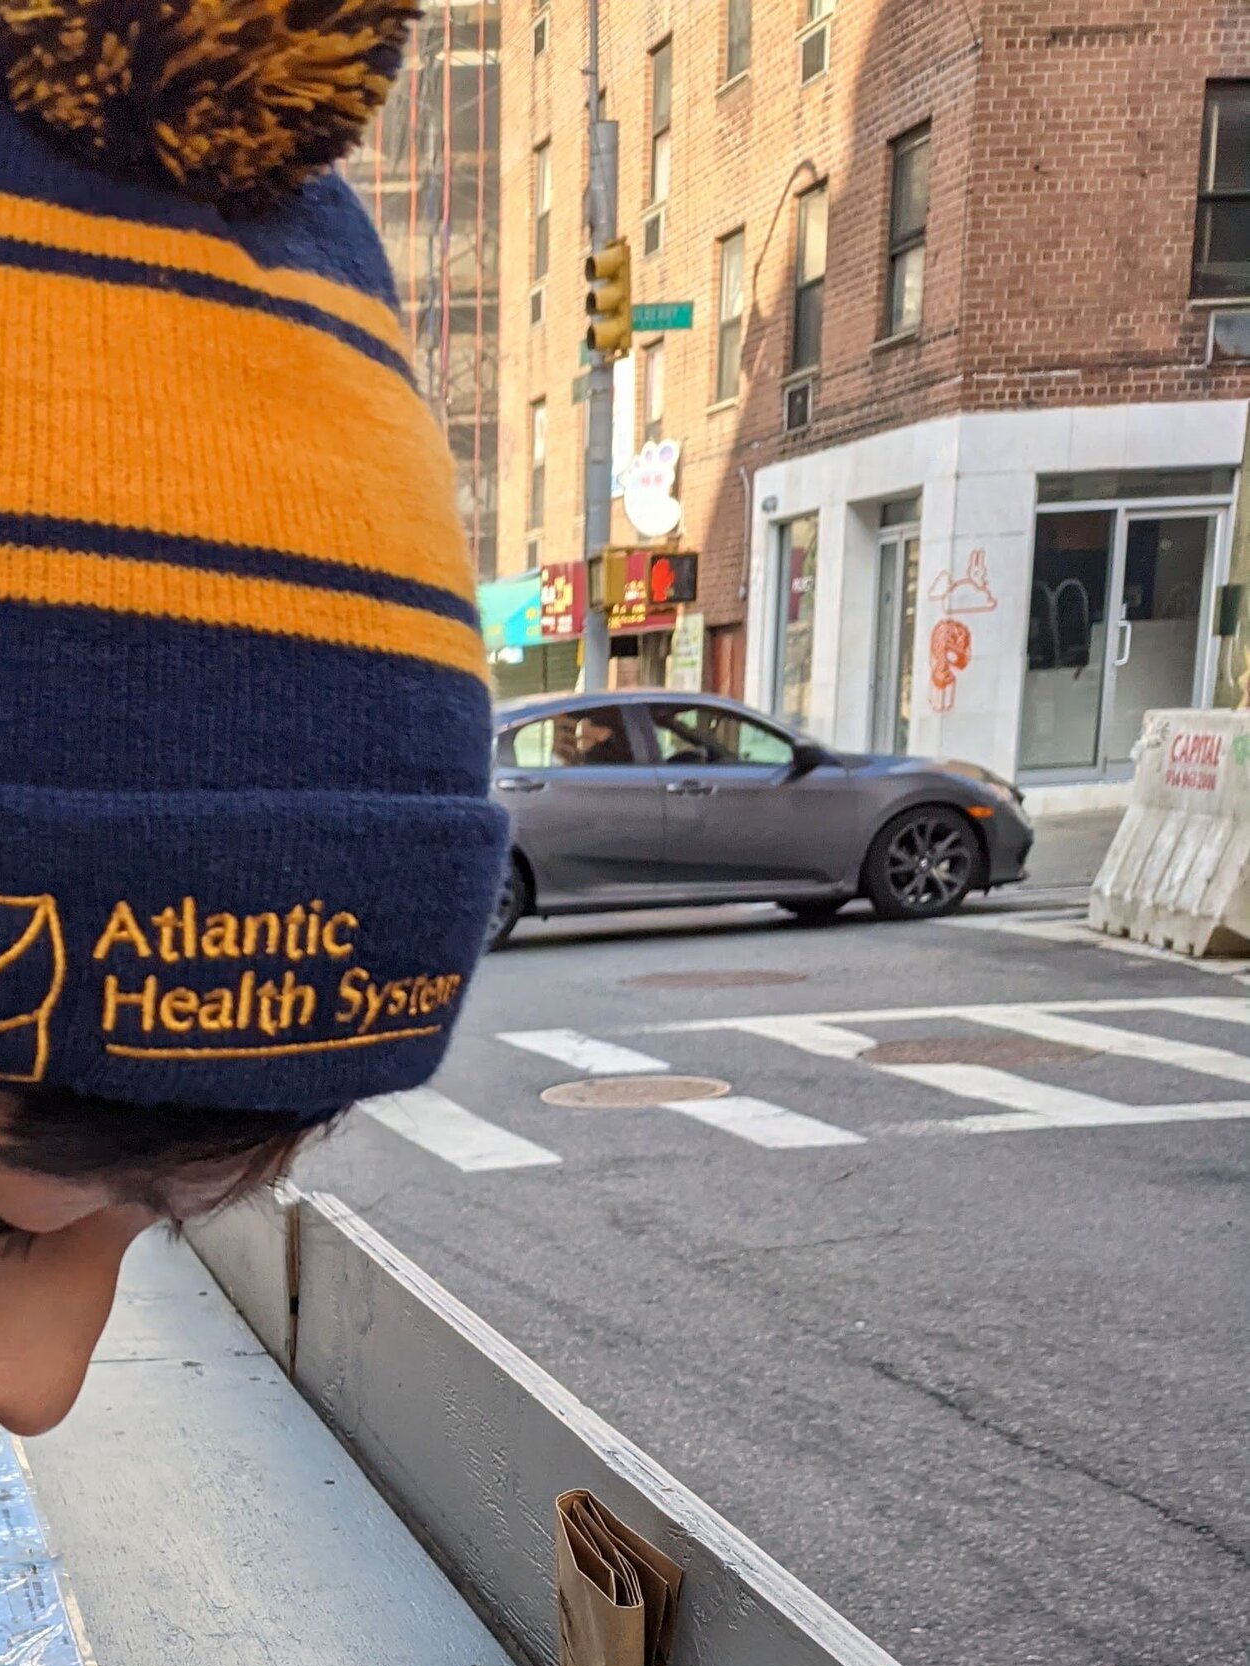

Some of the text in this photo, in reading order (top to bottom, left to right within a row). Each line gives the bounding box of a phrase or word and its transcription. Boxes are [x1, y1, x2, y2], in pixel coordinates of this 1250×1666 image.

[1170, 734, 1222, 766] CAPITAL
[92, 896, 359, 961] Atlantic
[100, 969, 316, 1035] Health
